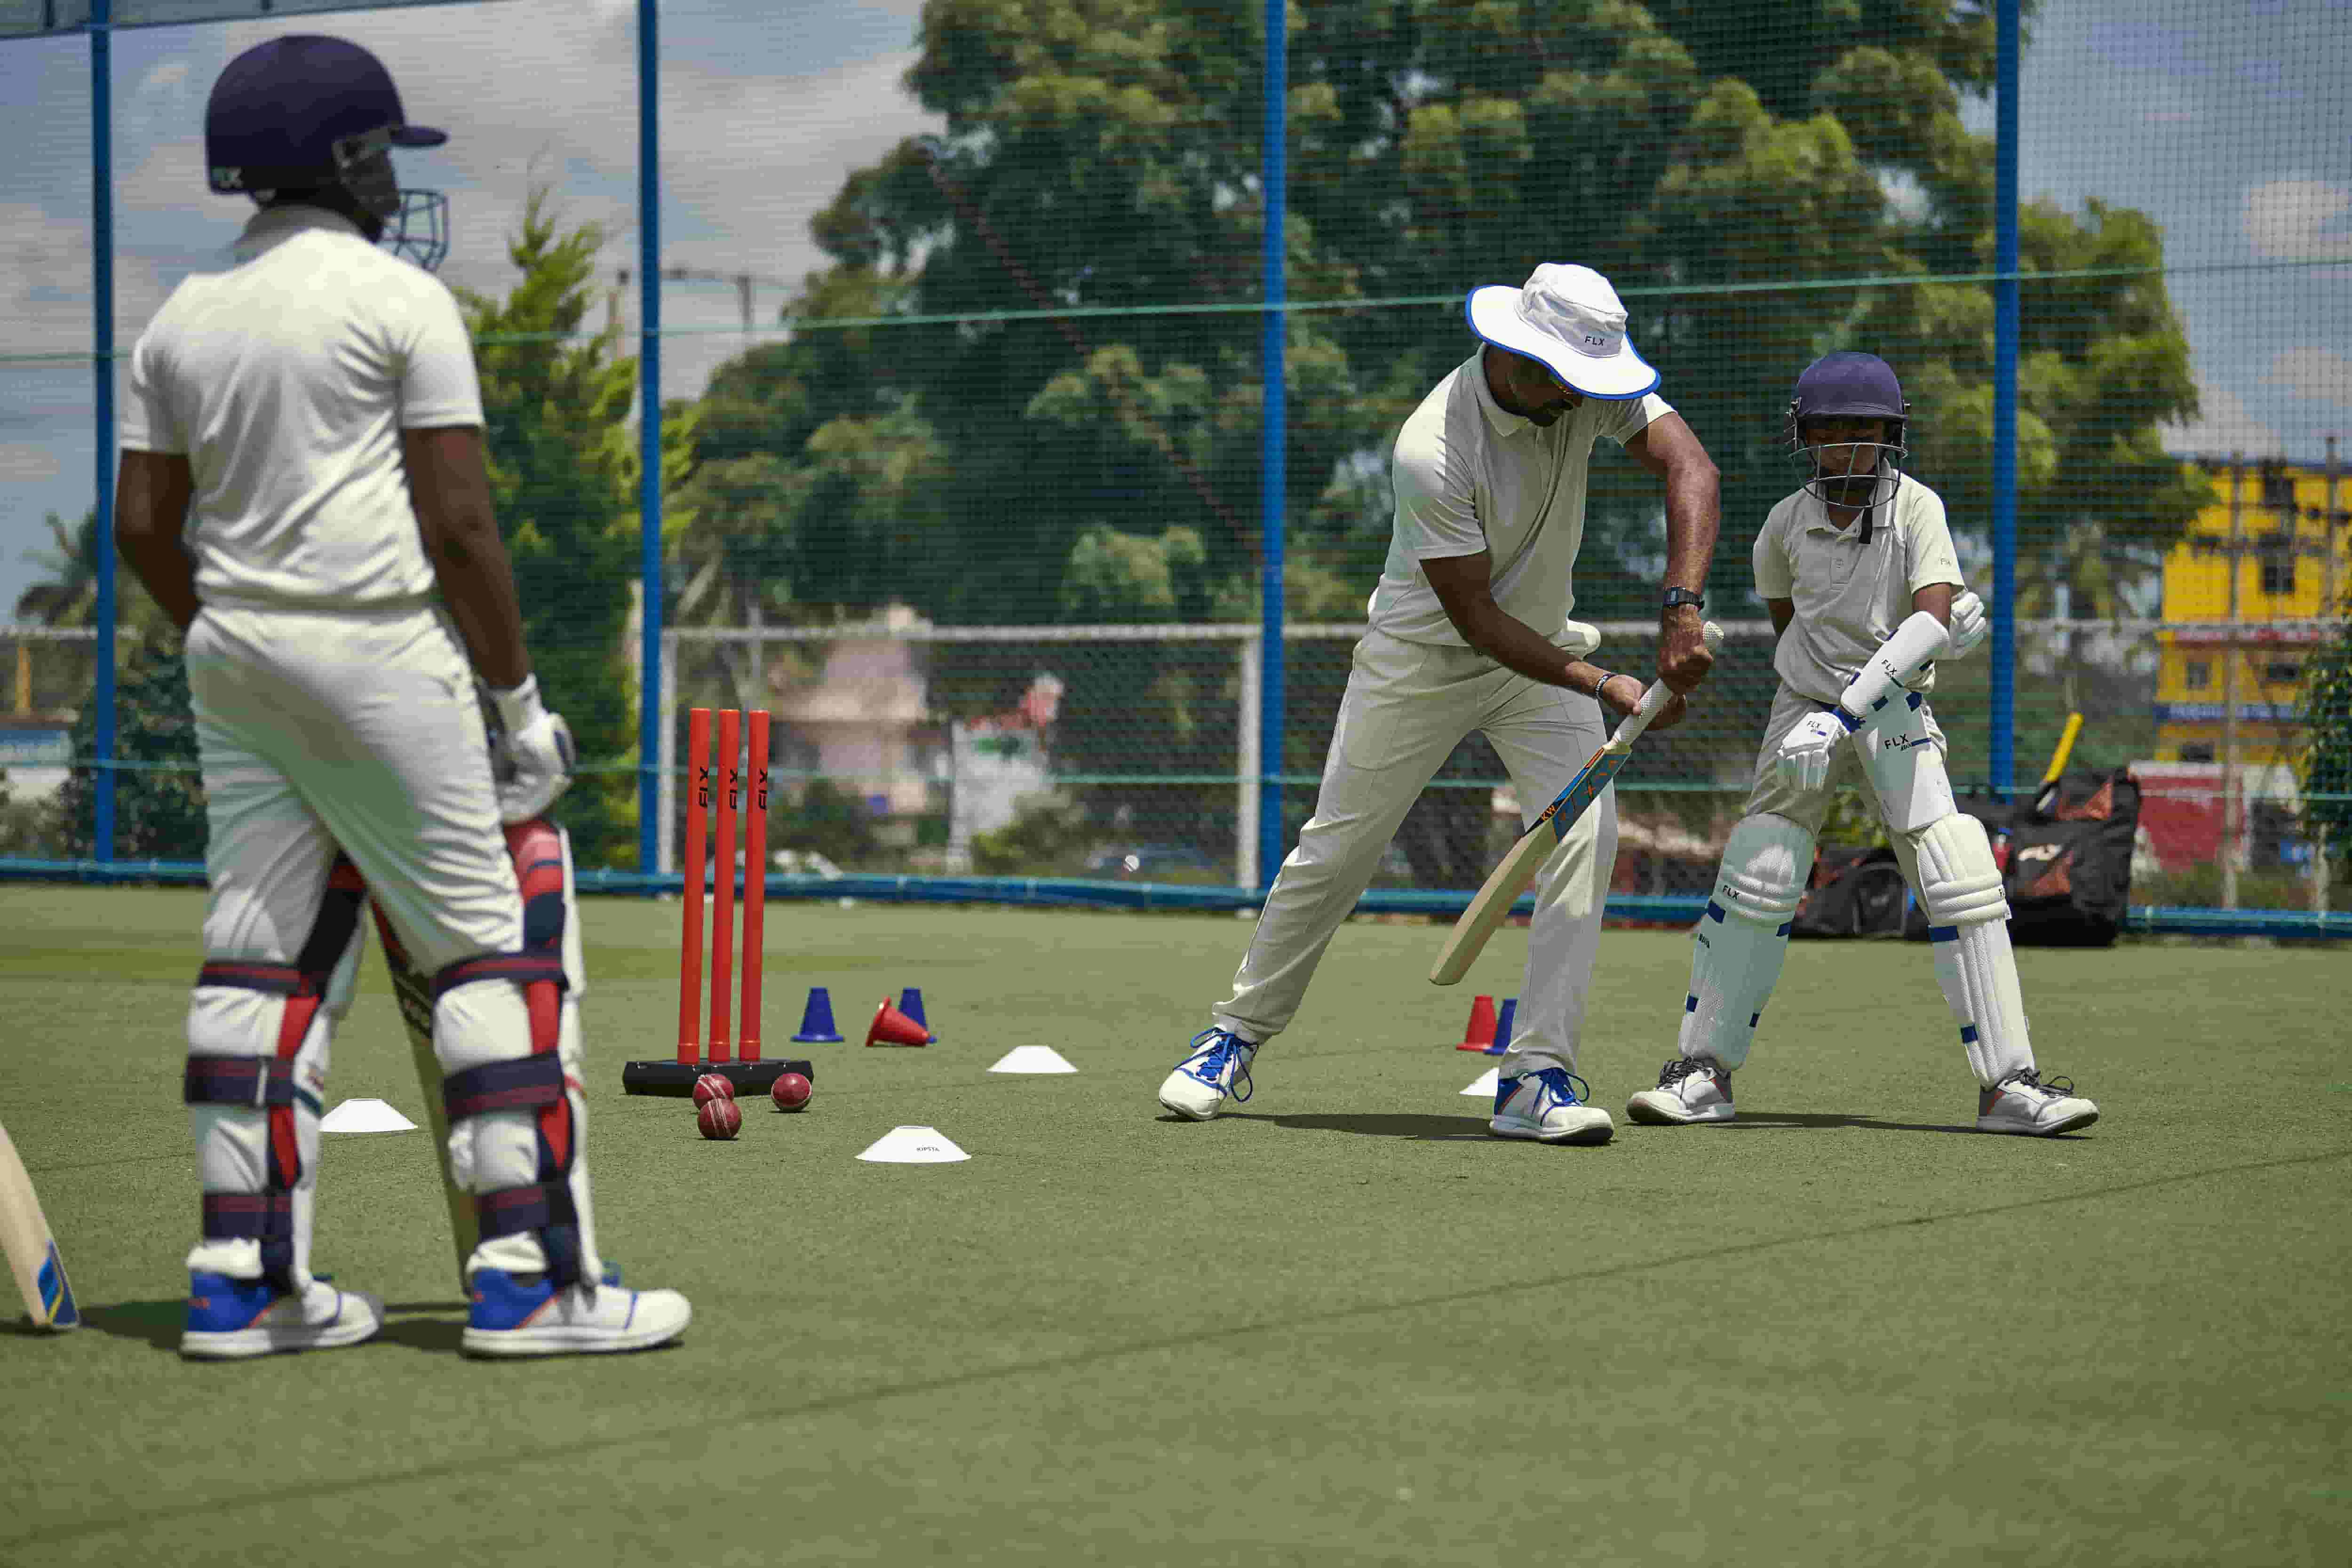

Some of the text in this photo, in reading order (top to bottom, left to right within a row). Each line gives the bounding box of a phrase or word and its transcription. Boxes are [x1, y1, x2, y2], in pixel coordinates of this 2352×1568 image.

[1585, 335, 1605, 346] FLX
[1882, 659, 1897, 675] FLX
[1884, 733, 1908, 749] FLX
[1723, 885, 1740, 900] FLX
